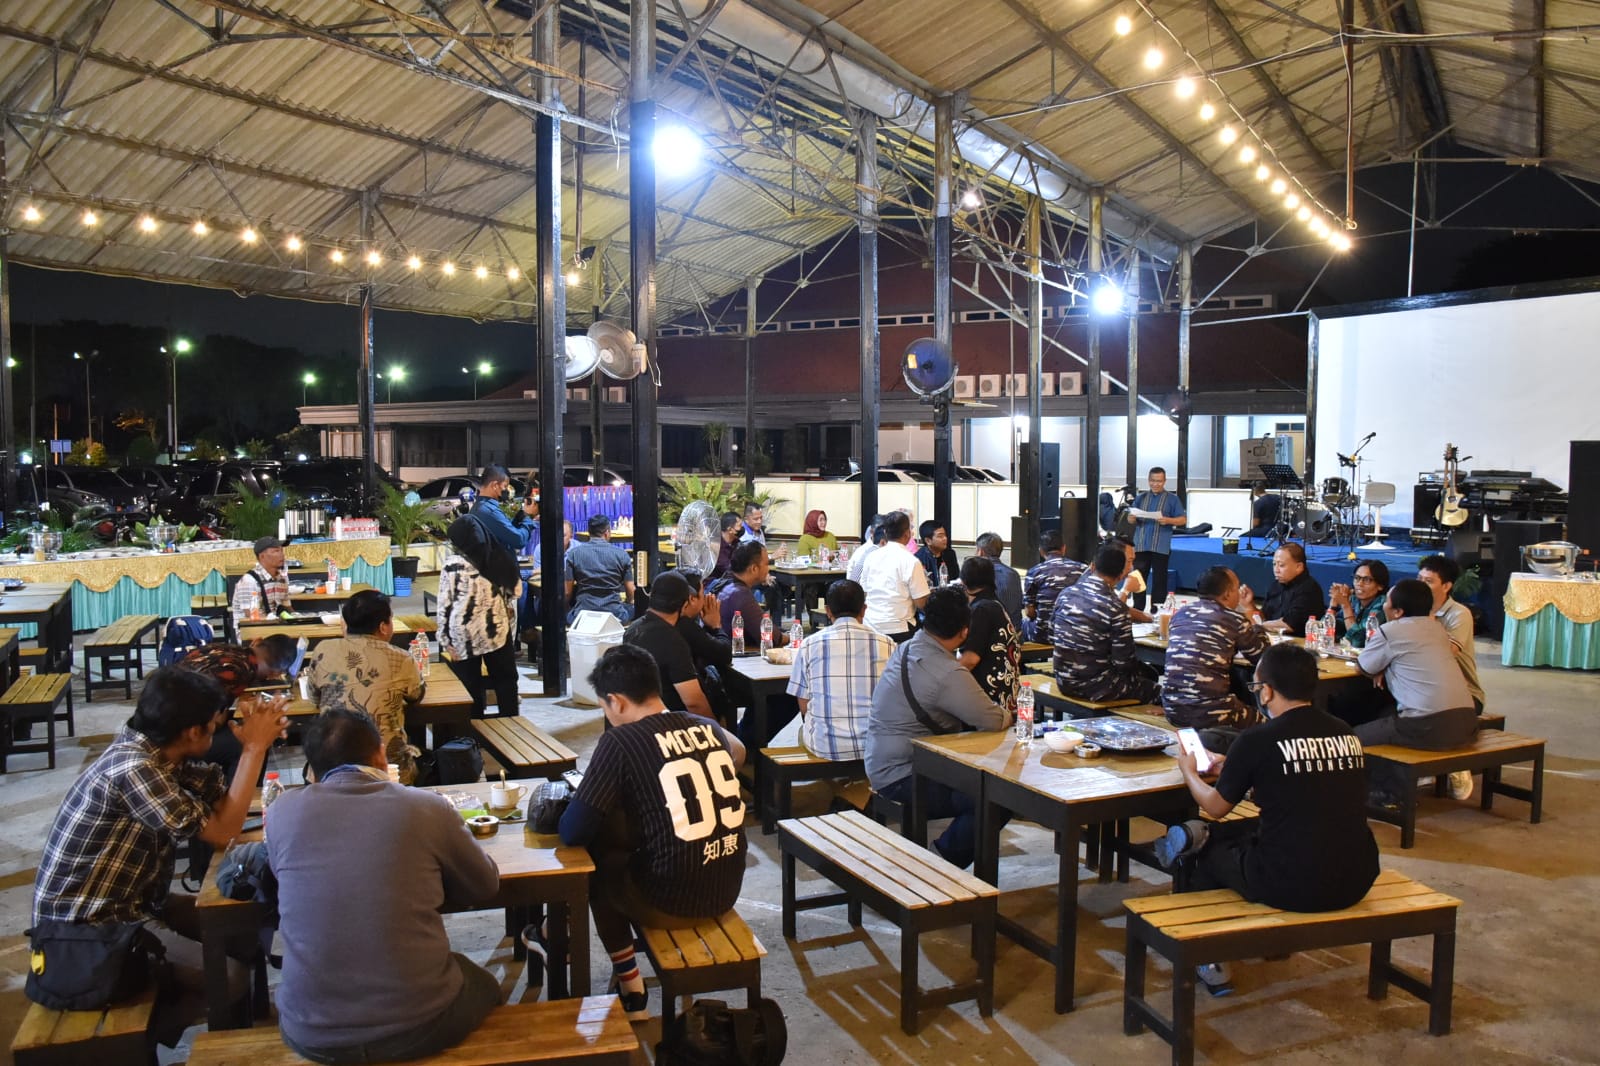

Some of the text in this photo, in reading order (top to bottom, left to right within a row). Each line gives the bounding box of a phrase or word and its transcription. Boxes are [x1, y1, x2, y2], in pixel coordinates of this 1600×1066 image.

[654, 724, 721, 759] MOCK
[1276, 734, 1363, 762] WARTAWAN
[658, 750, 746, 842] 09
[702, 833, 739, 865] 知恵
